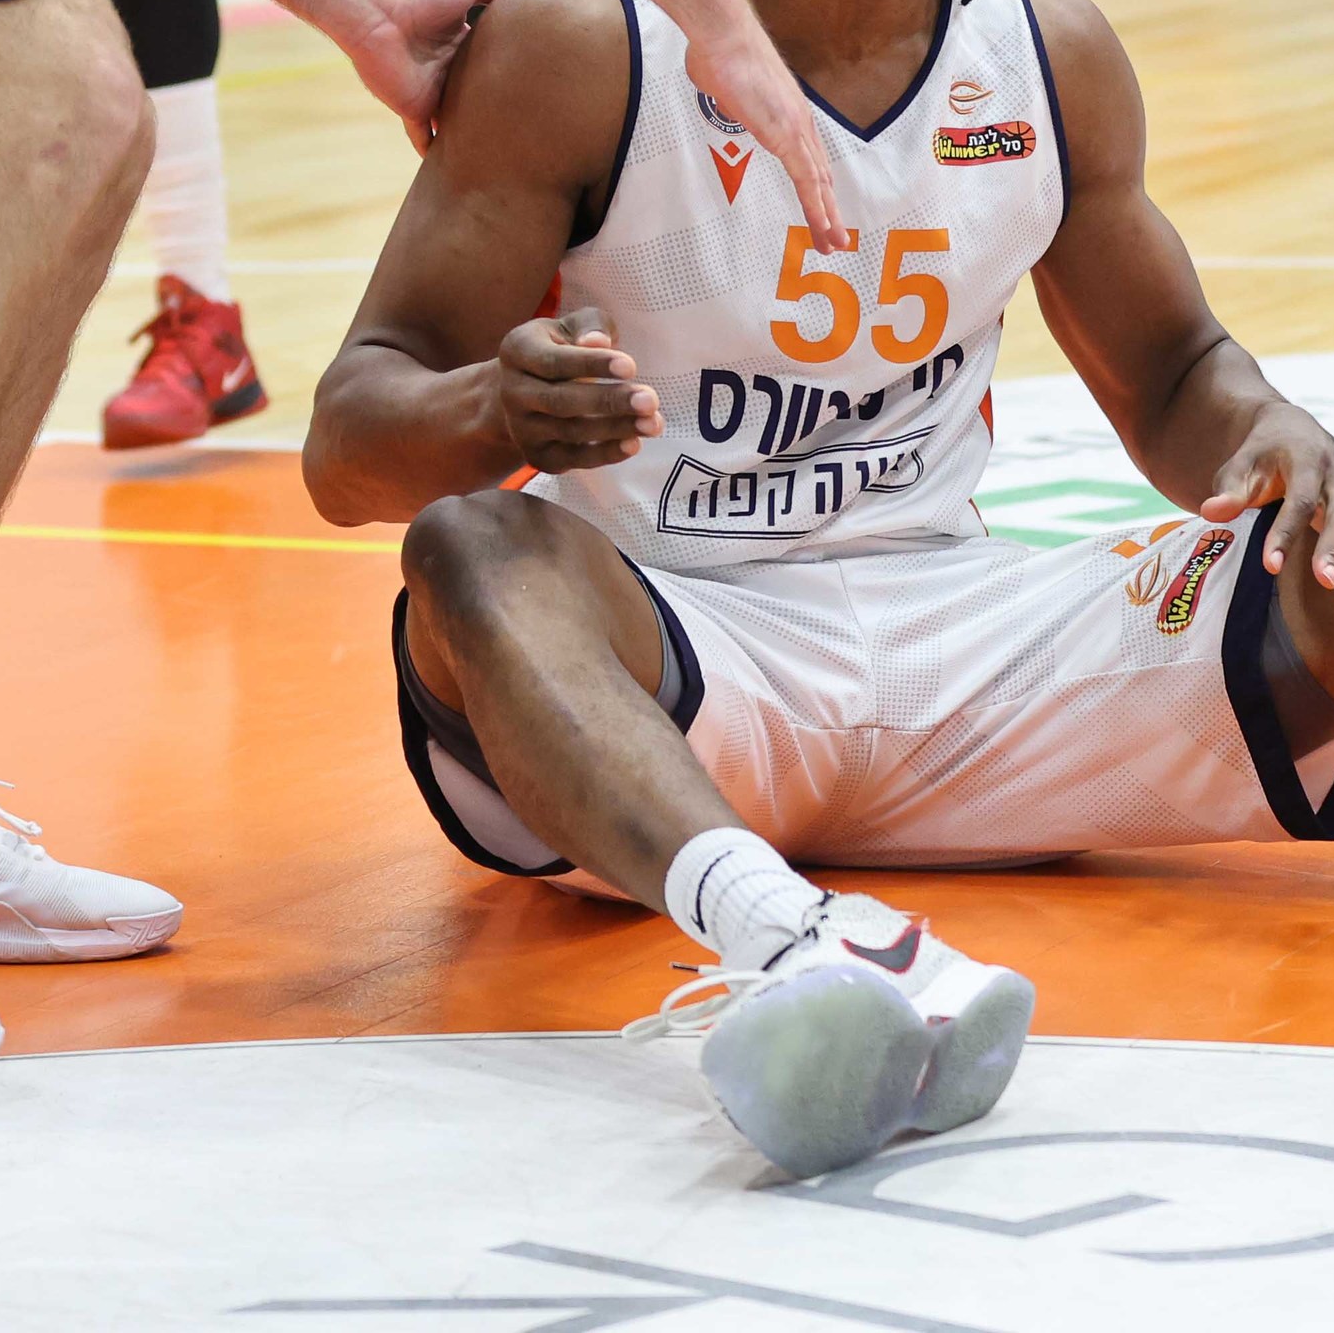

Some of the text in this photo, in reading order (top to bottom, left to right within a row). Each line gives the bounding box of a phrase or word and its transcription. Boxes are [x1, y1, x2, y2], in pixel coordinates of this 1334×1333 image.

[938, 138, 1000, 158] Winner
[1001, 137, 1022, 153] סל
[770, 225, 950, 364] 55
[1168, 556, 1213, 623] Winner
